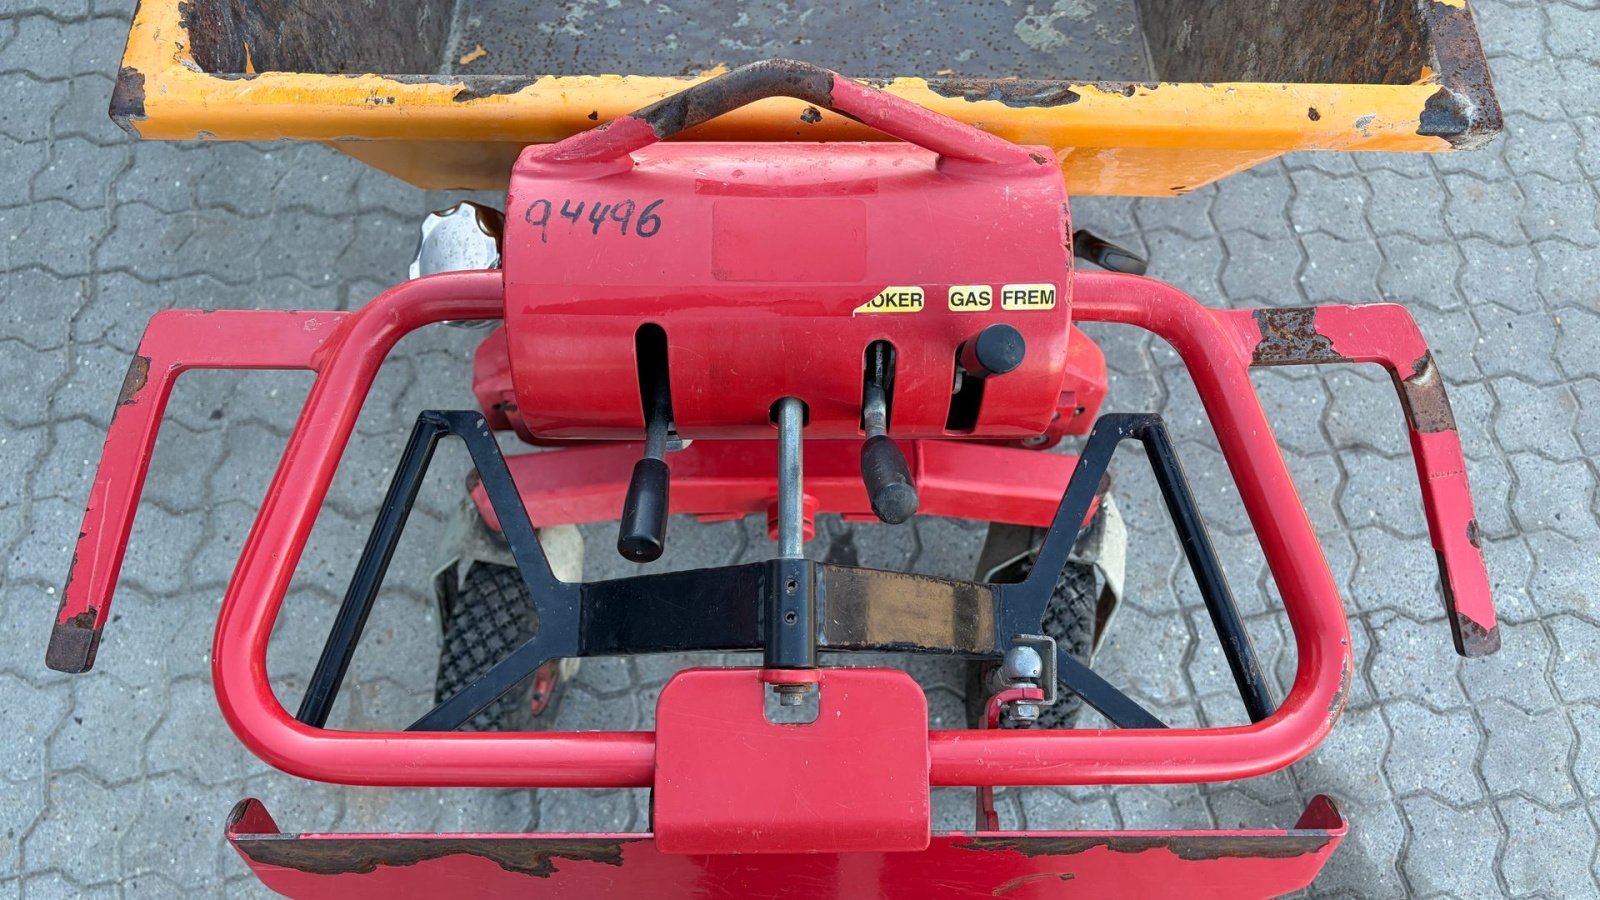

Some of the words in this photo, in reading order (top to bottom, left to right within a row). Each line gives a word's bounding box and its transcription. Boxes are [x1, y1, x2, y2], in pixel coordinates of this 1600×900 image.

[525, 199, 665, 243] 94496
[866, 292, 922, 308] OKER
[950, 291, 991, 307] GAS
[1002, 289, 1055, 305] FREM
